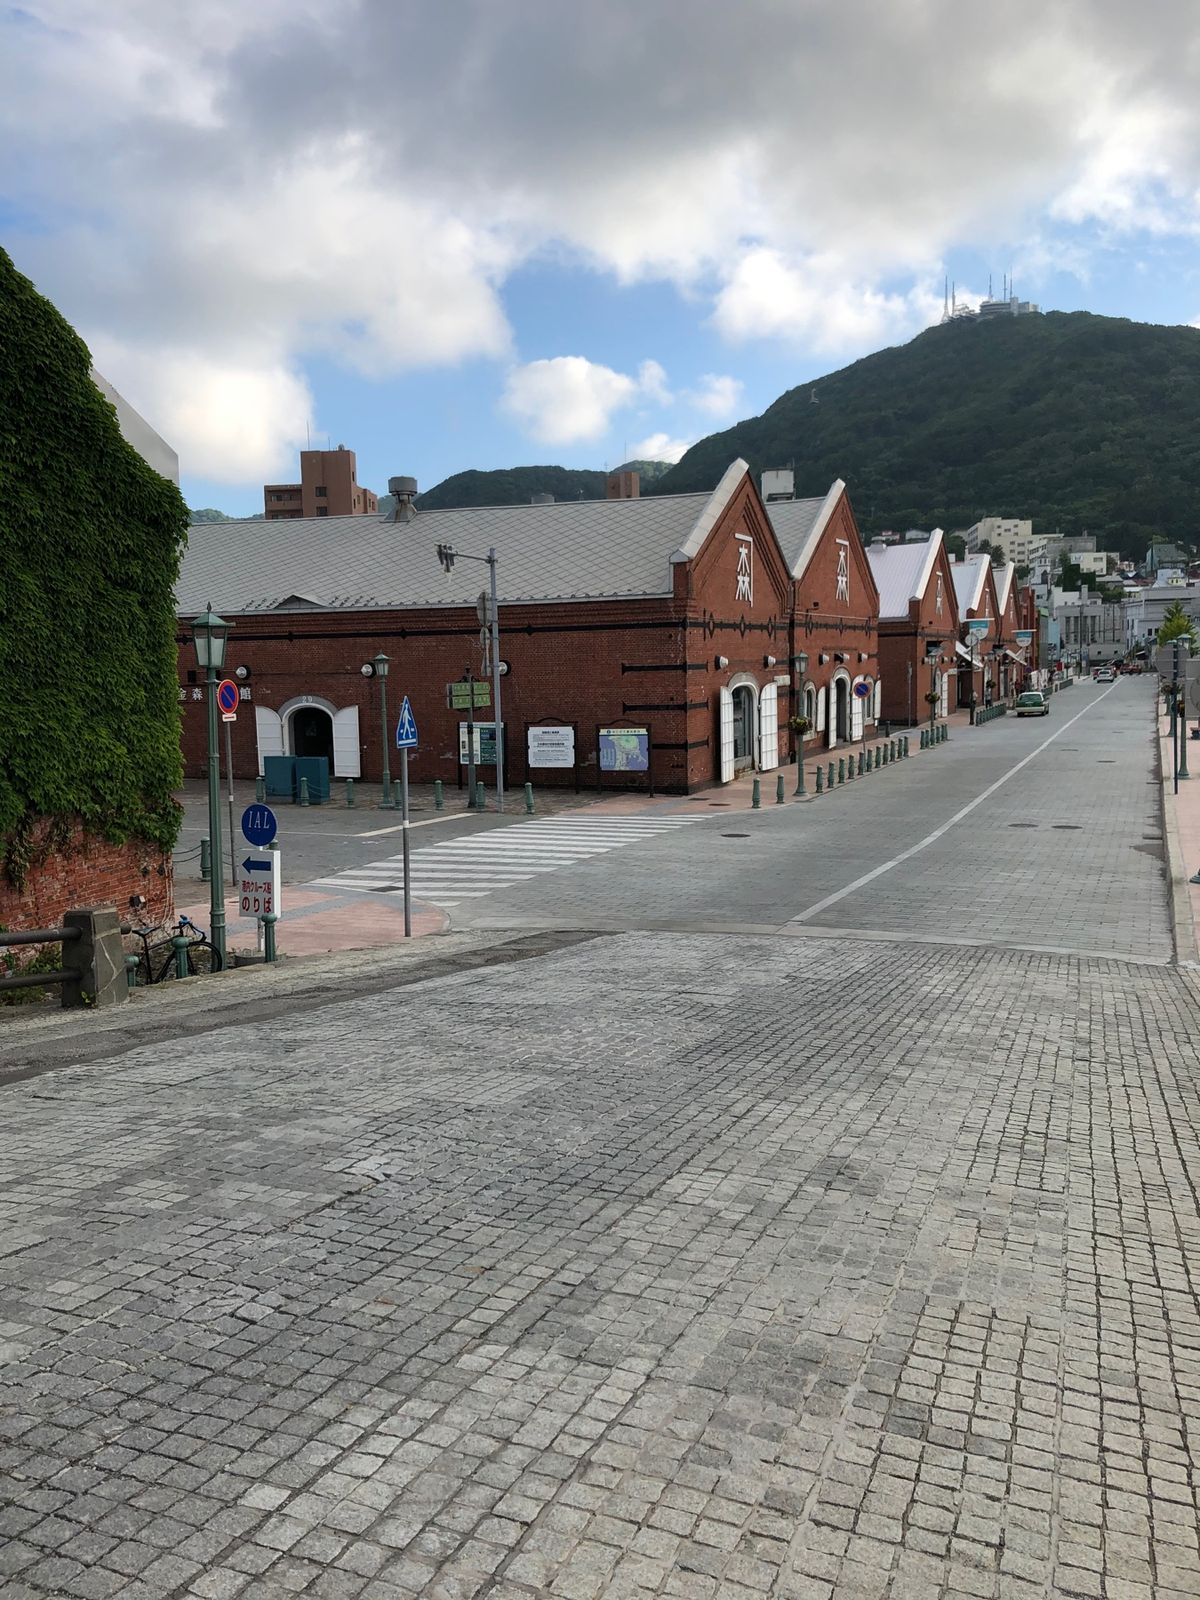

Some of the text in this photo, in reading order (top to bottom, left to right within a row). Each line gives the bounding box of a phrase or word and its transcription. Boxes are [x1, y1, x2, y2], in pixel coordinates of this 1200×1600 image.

[177, 686, 252, 701] 金森館
[241, 896, 272, 914] のりば
